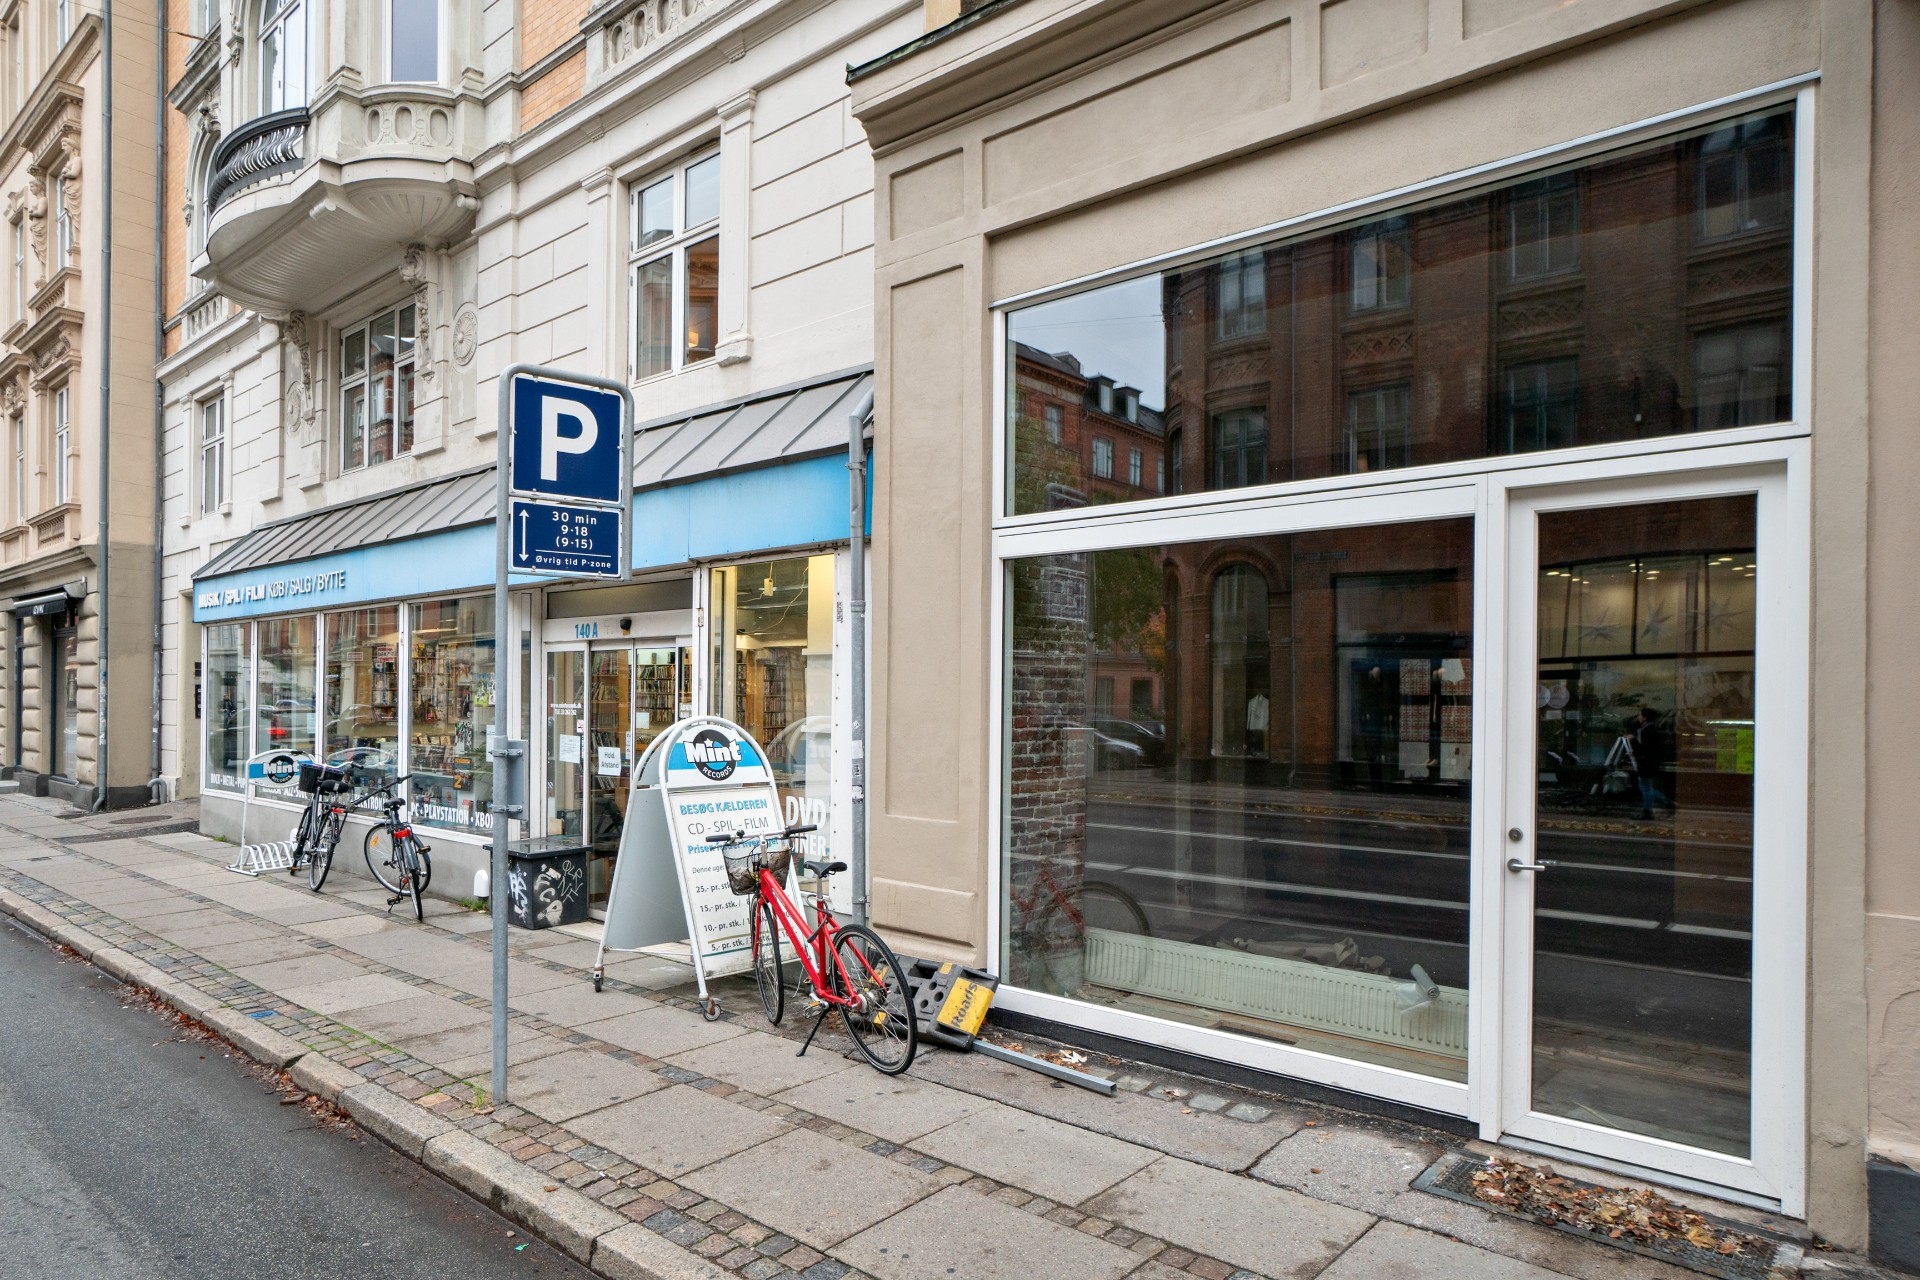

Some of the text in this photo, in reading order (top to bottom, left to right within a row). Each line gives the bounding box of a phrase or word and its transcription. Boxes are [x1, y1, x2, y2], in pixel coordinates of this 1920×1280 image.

[541, 395, 598, 481] P
[552, 511, 597, 525] 30 min
[535, 555, 561, 566] Øvrig
[565, 558, 578, 566] tid
[198, 592, 220, 609] MUSIK
[225, 589, 241, 605] SPIL
[246, 584, 266, 601] FILM
[268, 581, 284, 598] KØB
[290, 576, 311, 595] SALG
[318, 570, 346, 591] BYTTE
[575, 622, 598, 639] 140 A
[683, 739, 742, 763] Mint
[702, 766, 732, 778] RECORDS
[411, 802, 419, 816] PC
[424, 803, 469, 825] PLAYSTATION
[679, 799, 768, 815] BESØG KÆLDEREN
[786, 796, 827, 830] DVD
[688, 822, 704, 835] CD
[714, 820, 737, 833] SPIL
[744, 817, 769, 829] FILM
[692, 866, 711, 874] Denne
[715, 903, 724, 912] pr.
[725, 900, 737, 908] stk.
[718, 923, 728, 931] pr.
[728, 919, 741, 928] stk.
[722, 942, 731, 951] pr.
[732, 938, 745, 948] stk.
